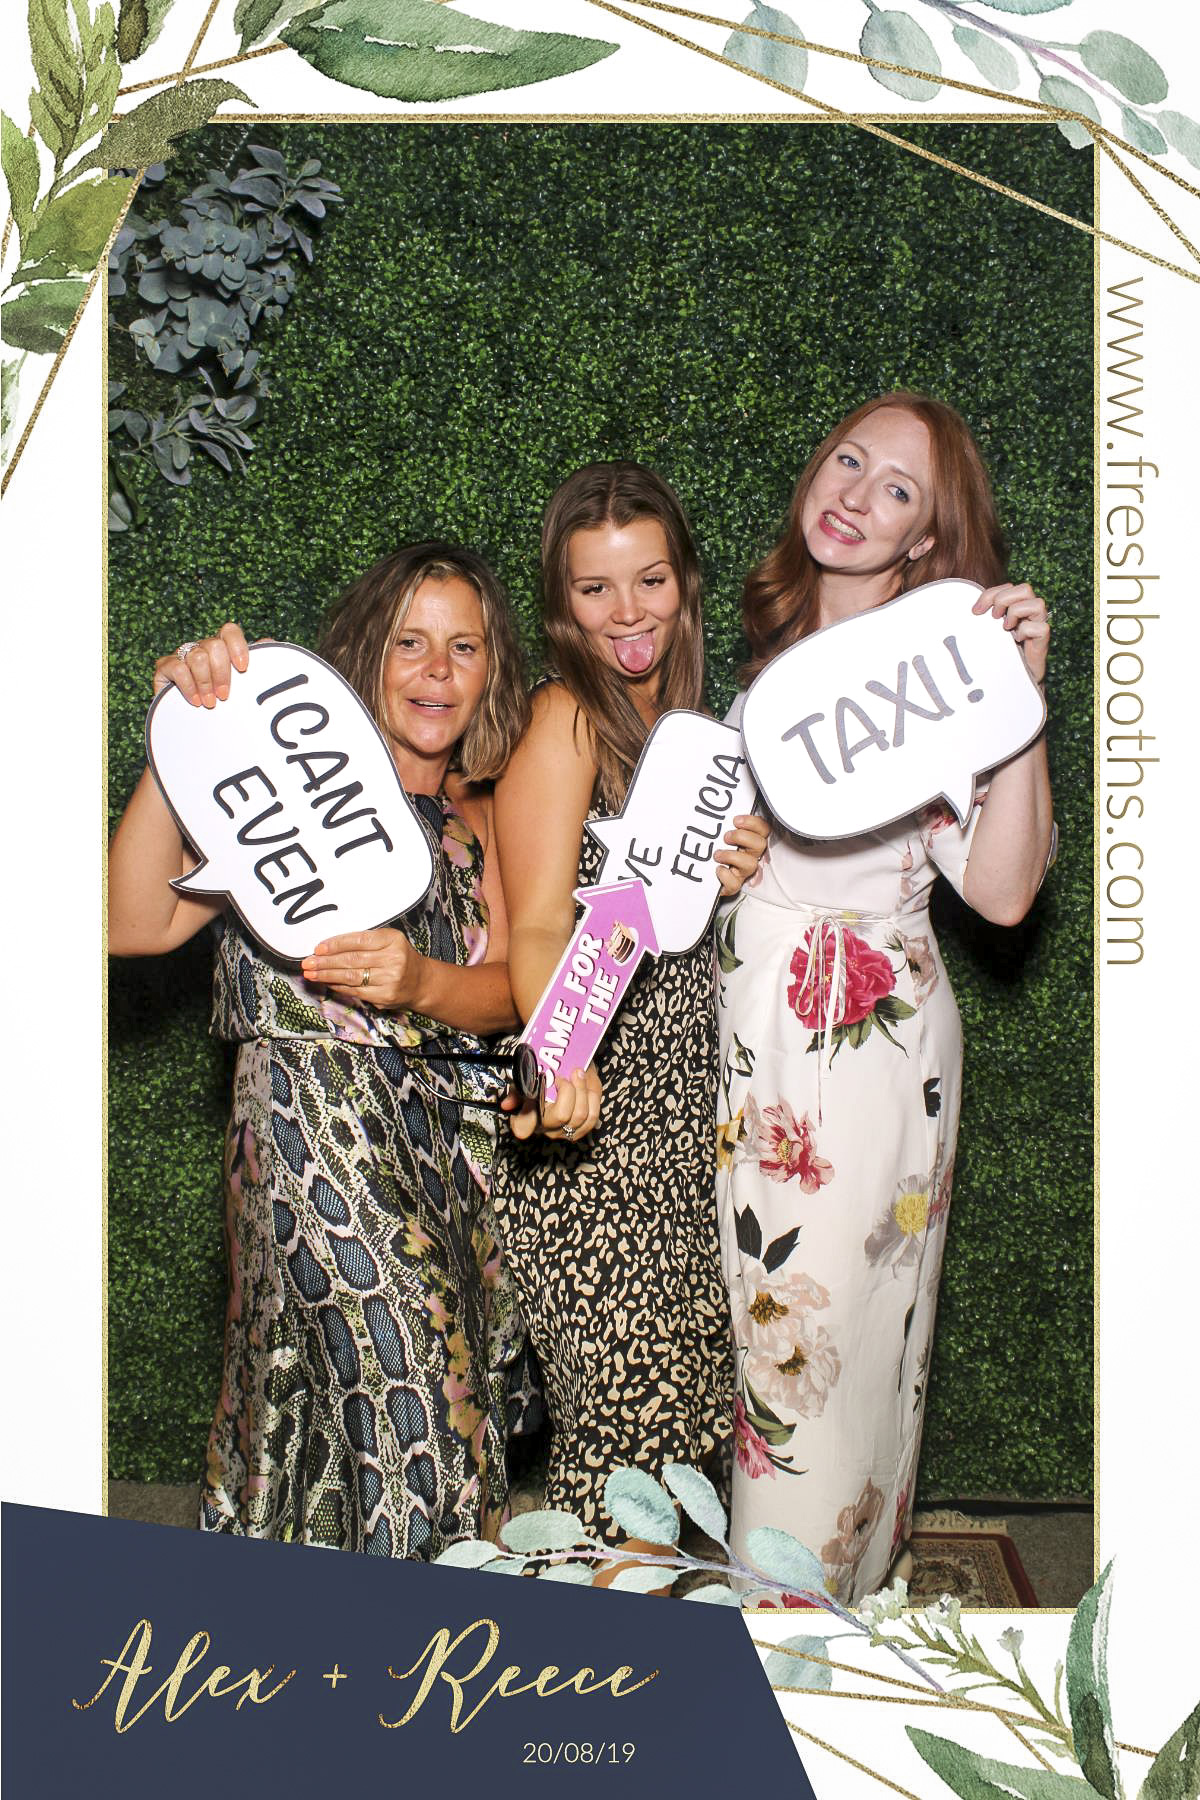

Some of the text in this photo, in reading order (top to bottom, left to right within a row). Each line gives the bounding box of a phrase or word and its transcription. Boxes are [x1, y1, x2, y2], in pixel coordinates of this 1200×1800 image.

[780, 635, 985, 785] TAXI!
[212, 765, 339, 925] EVEN
[618, 838, 662, 887] YE
[671, 753, 746, 883] FELICIA
[563, 932, 604, 996] FOR
[580, 967, 621, 1026] THE
